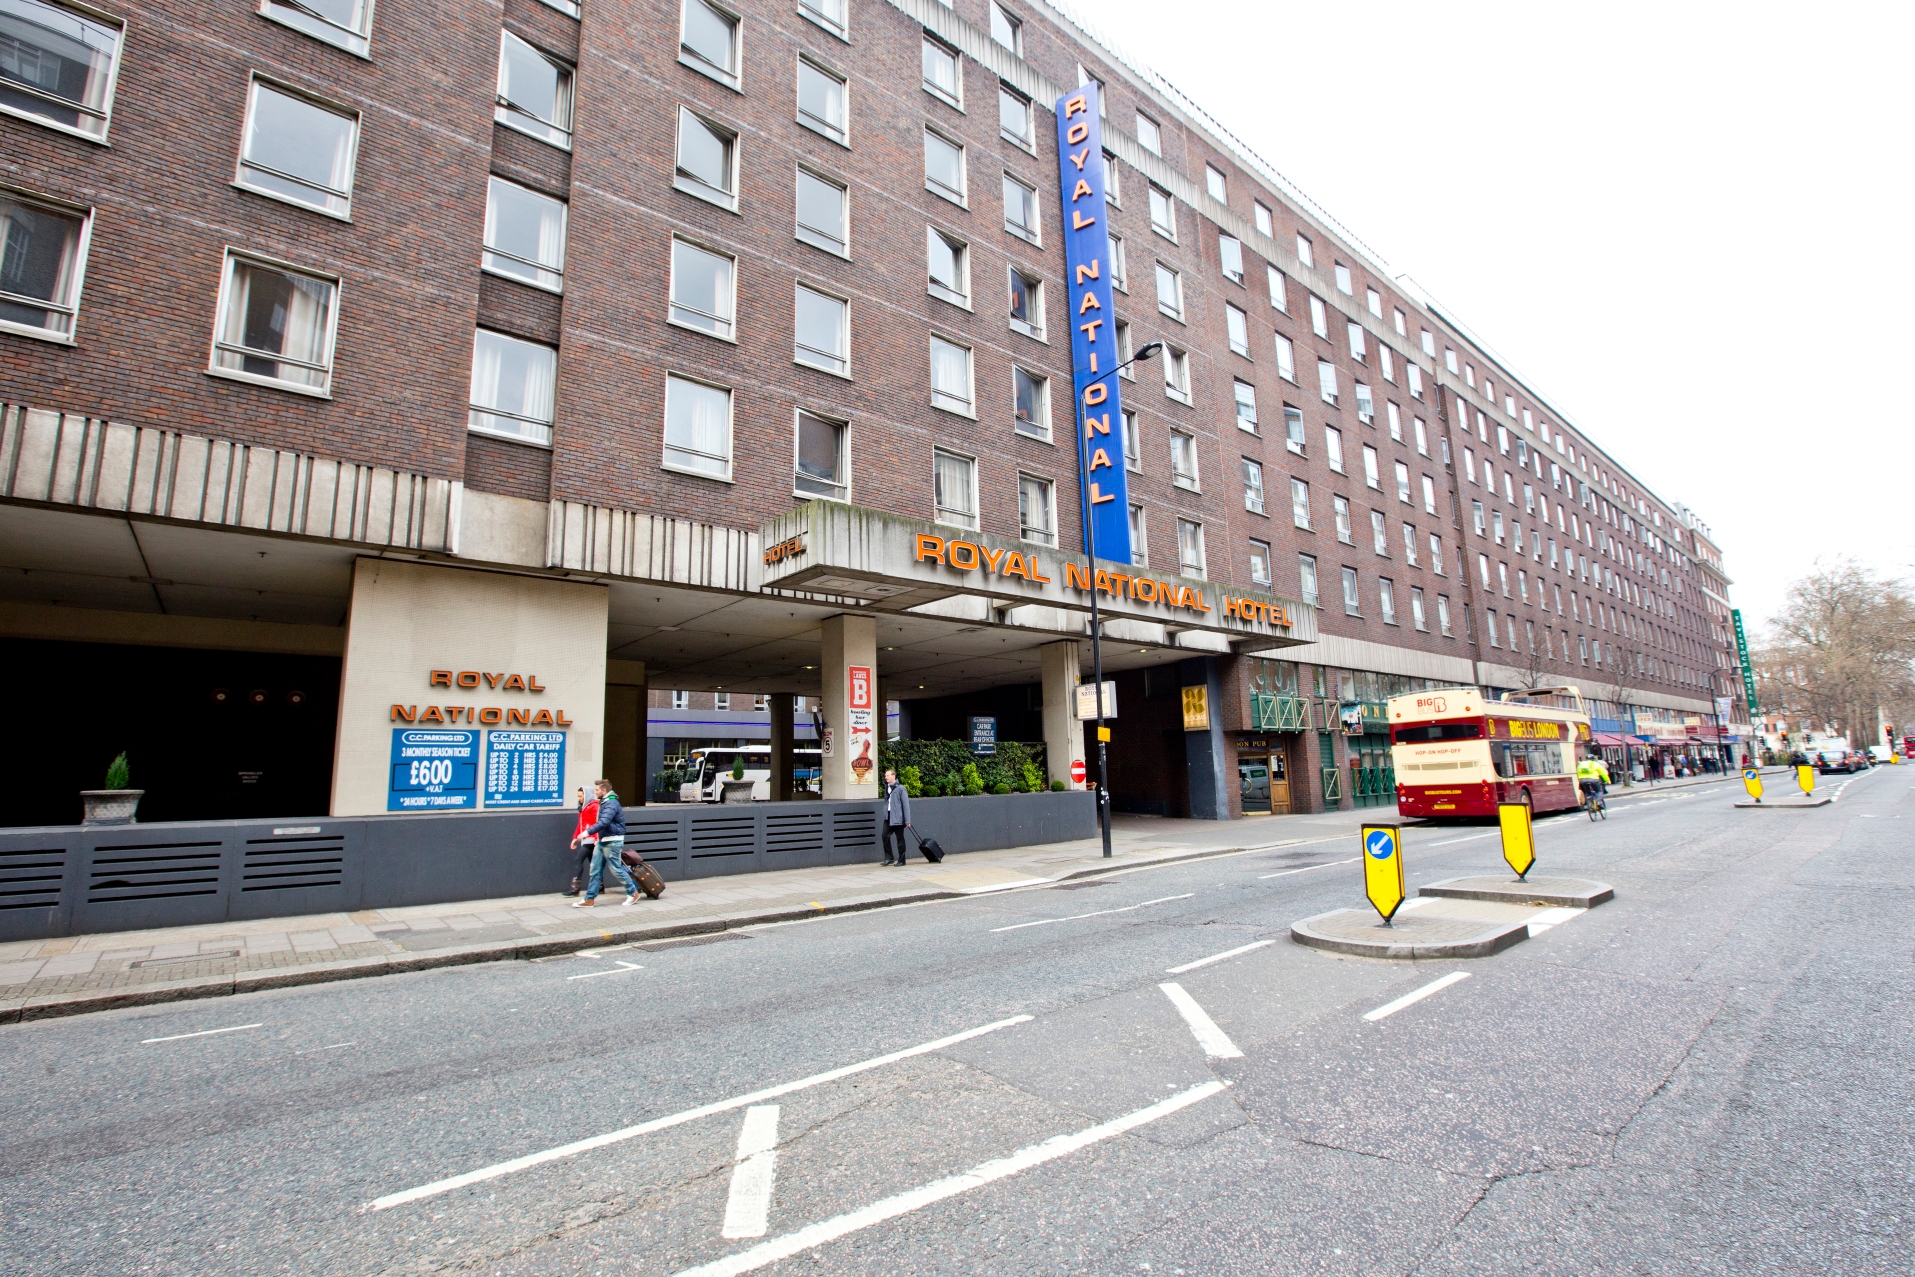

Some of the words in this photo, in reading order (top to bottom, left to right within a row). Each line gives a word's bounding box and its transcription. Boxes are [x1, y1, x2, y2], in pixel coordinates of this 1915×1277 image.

[1065, 94, 1095, 230] ROYAL
[1076, 259, 1114, 504] NATIONAL
[764, 538, 802, 564] HOTEL
[916, 533, 1050, 584] ROYAL
[1066, 562, 1211, 612] NATIONAL
[1225, 596, 1294, 627] HOTEL
[1734, 616, 1748, 667] TAVISTOCK
[1744, 672, 1754, 700] HOTEL
[430, 670, 546, 691] ROYAL
[853, 679, 867, 705] B
[1417, 698, 1432, 707] BIG
[1418, 706, 1434, 715] BUS
[391, 705, 572, 725] NATIONAL
[1534, 722, 1559, 738] LONDON
[402, 747, 406, 757] 3
[406, 747, 431, 757] MONTHLY
[432, 748, 453, 757] SEASON
[454, 748, 471, 757] TICKET
[826, 740, 830, 750] 5
[410, 760, 452, 785] £600
